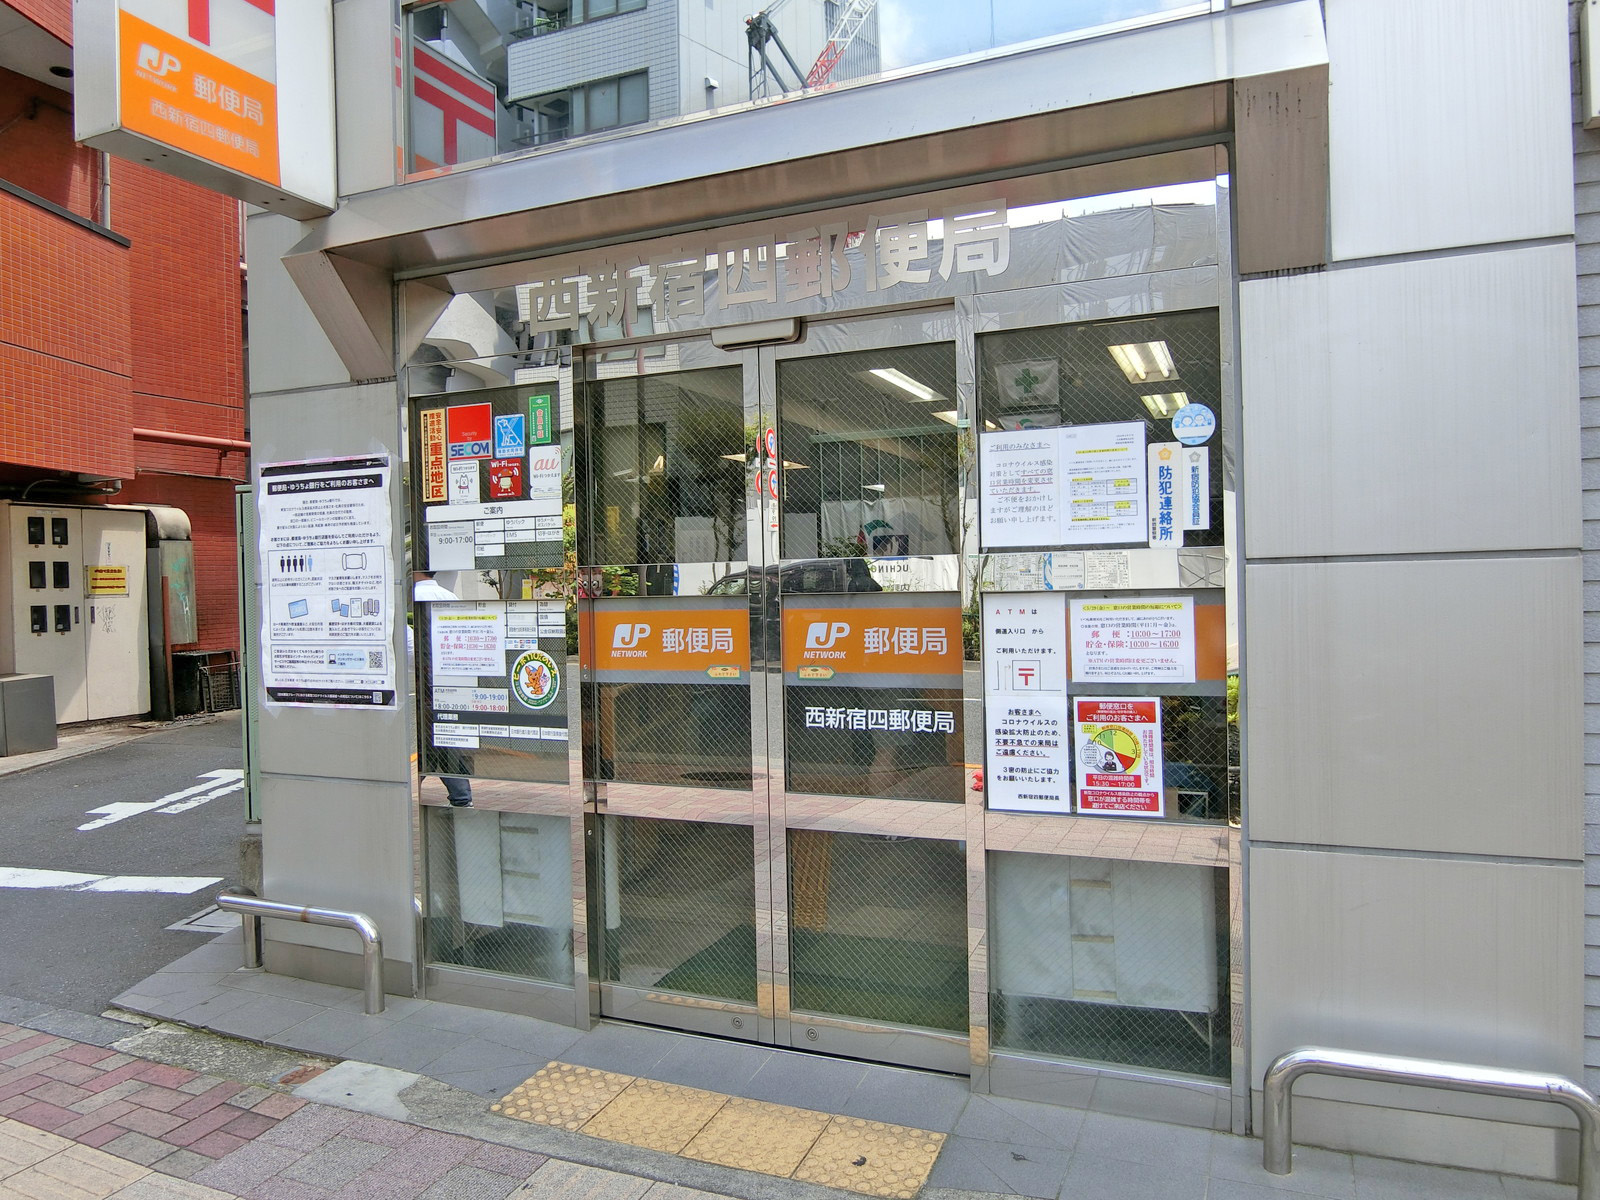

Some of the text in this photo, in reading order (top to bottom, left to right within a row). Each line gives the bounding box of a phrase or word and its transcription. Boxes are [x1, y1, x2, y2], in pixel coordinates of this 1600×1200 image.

[137, 42, 182, 76] JP
[193, 73, 264, 126] 郵便局
[150, 97, 260, 158] 西新宿四郵便局
[528, 197, 1012, 337] 西新宿四郵便局
[451, 442, 490, 457] SECOM
[989, 441, 1051, 452] ご利用のみなさまへ
[534, 458, 560, 471] au
[996, 459, 1053, 468] コロナウイルス感染
[430, 443, 444, 498] 重点地区
[997, 495, 1053, 504] ご不便をおかけし
[1158, 465, 1173, 541] 防犯連絡所
[483, 506, 503, 515] ご案内
[990, 505, 1053, 514] ますがご理解のほど
[990, 516, 1057, 524] お願い申し上げます。
[438, 536, 473, 545] 9:00-17:00
[612, 623, 651, 649] JP
[805, 622, 850, 649] JP
[662, 628, 734, 654] 郵便局
[863, 626, 948, 656] 郵便局
[611, 650, 648, 658] NETWORK
[803, 650, 846, 660] NETWORK
[805, 706, 955, 734] 西新宿四郵便局
[1086, 714, 1149, 722] ご利用のお客さまへ
[995, 738, 1059, 747] 不要不急での来局は
[995, 749, 1047, 757] ご遠慮ください。
[997, 775, 1056, 783] をお願いいたします。
[1088, 796, 1151, 804] 窓口が混雑する時間帯を
[1092, 802, 1148, 810] 避けてご来店ください
